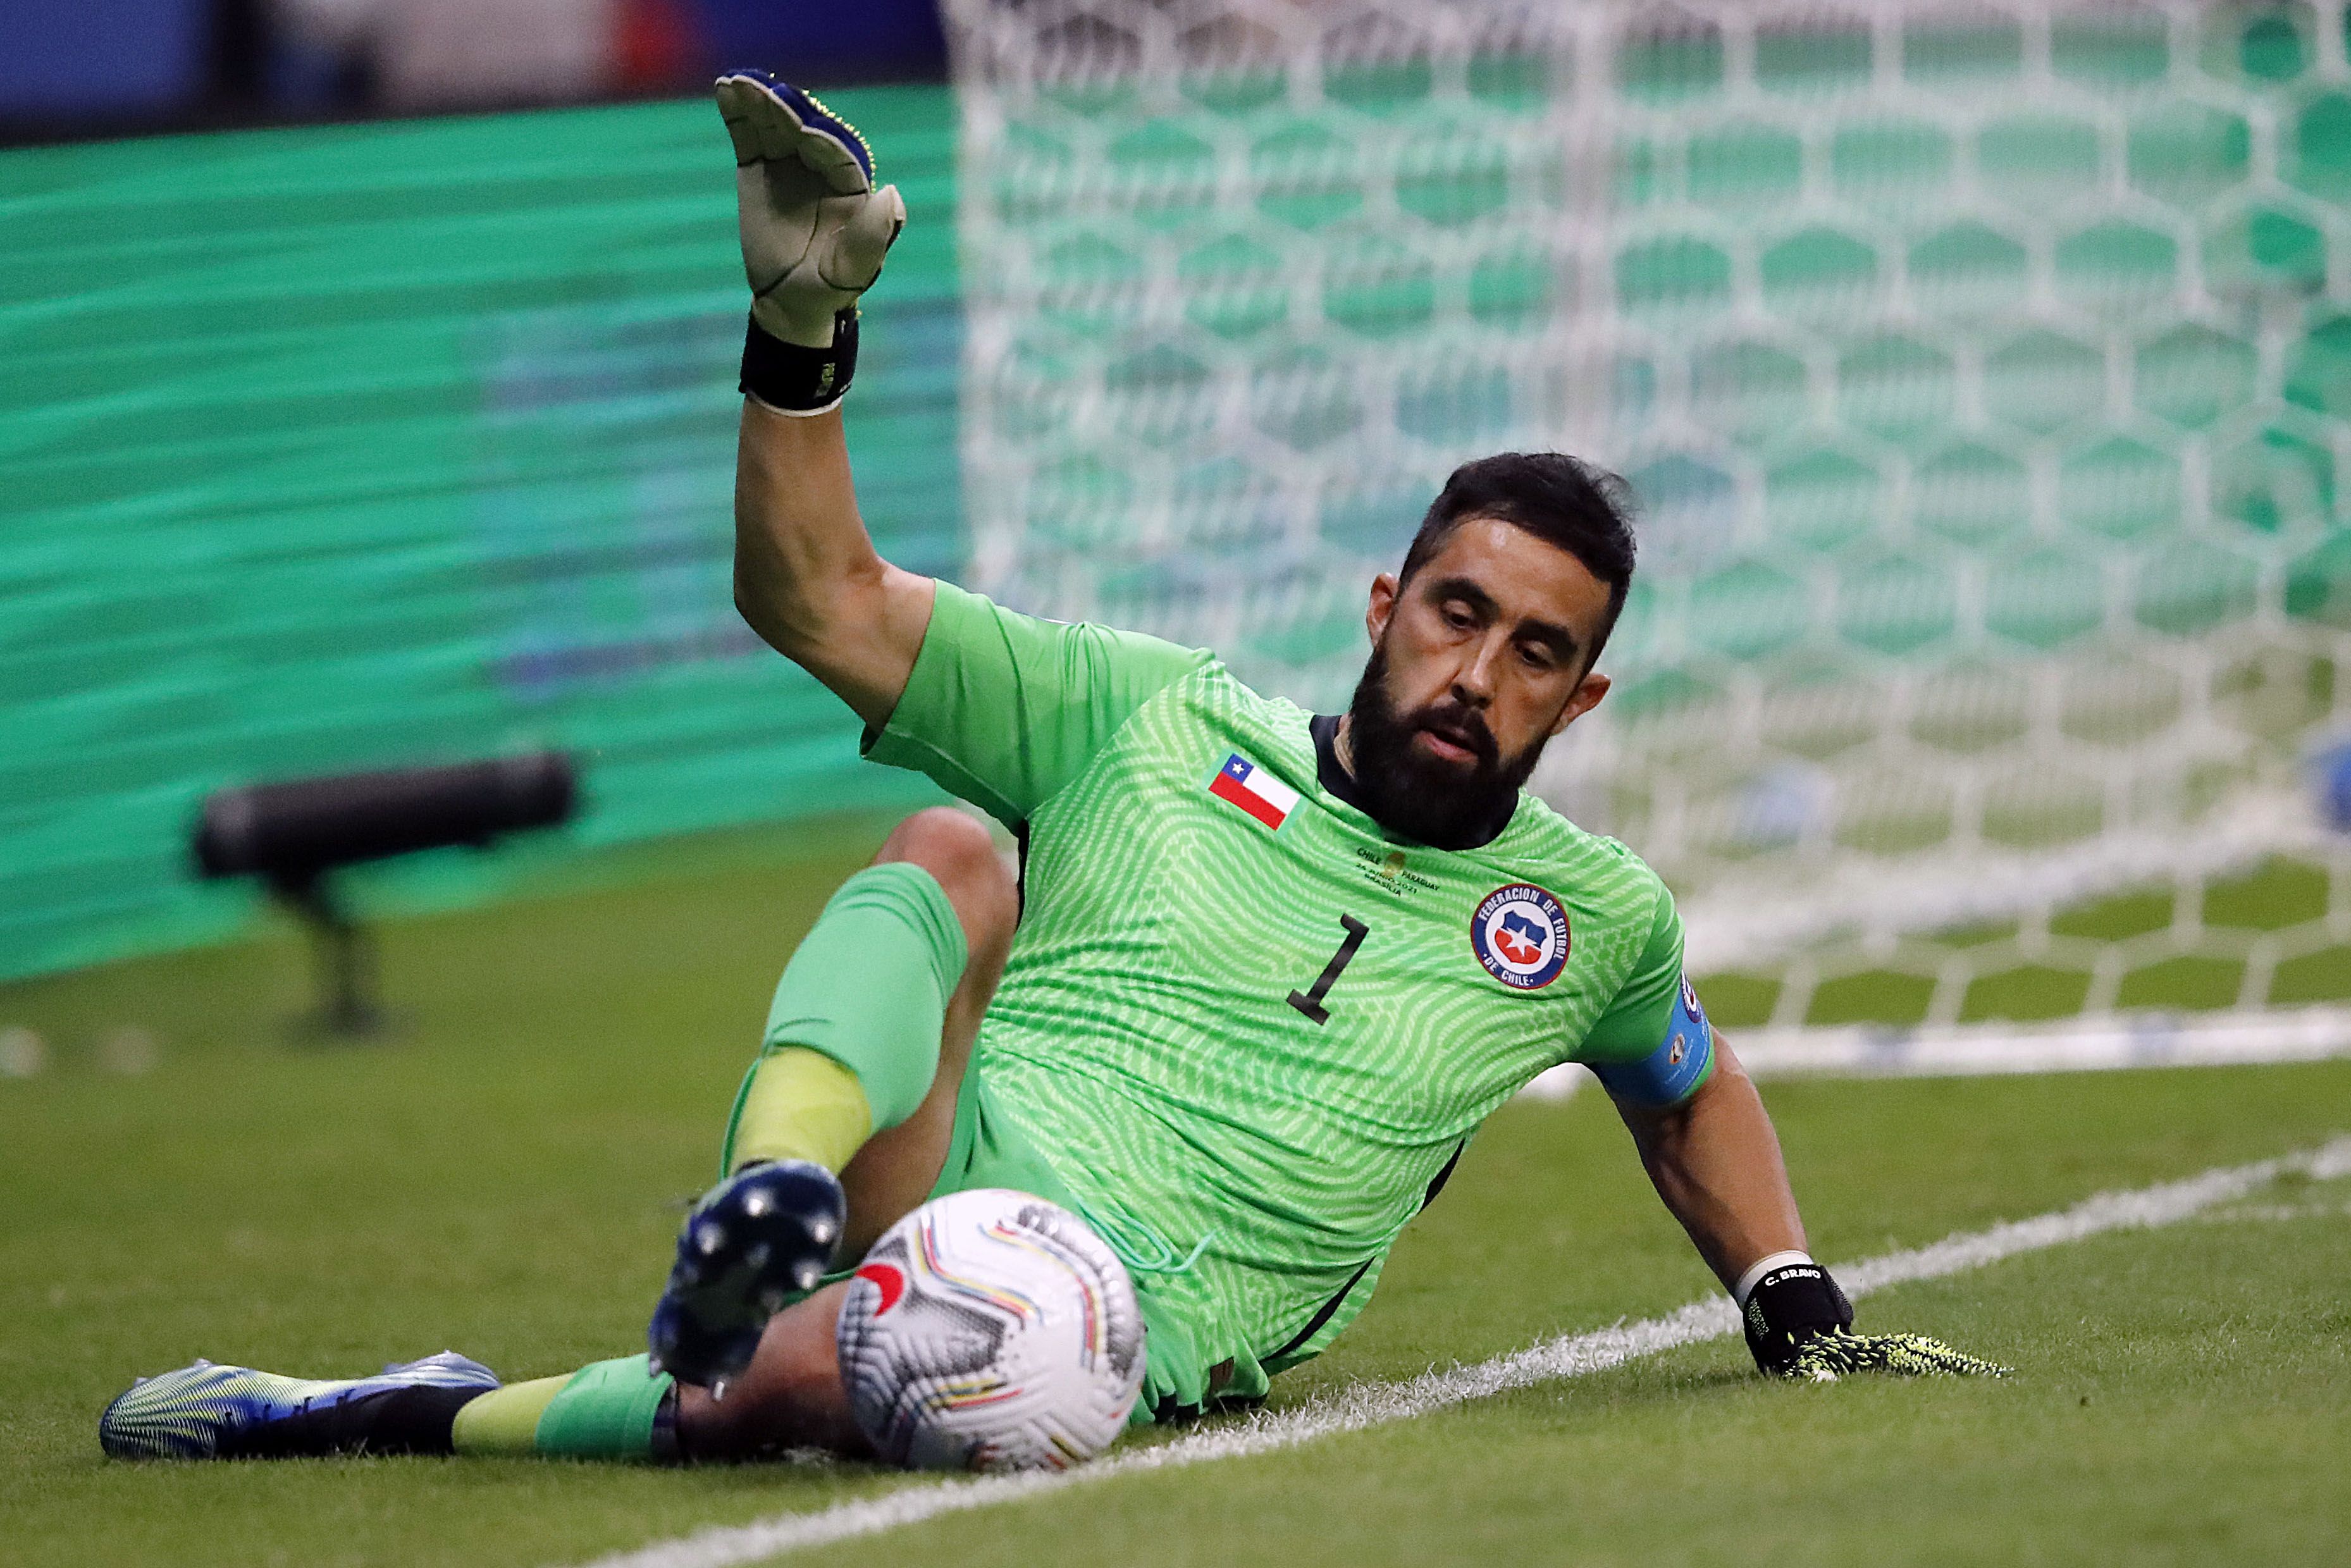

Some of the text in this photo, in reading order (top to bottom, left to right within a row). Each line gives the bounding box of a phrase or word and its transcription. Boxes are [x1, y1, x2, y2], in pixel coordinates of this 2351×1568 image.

[1357, 847, 1440, 891] CHILE PARAGUAY
[1478, 887, 1567, 960] FEDERACION DE FUTBOL
[1287, 913, 1369, 1026] 1
[1485, 958, 1529, 986] DE CHILE
[1765, 1269, 1822, 1287] C. BRAVO
